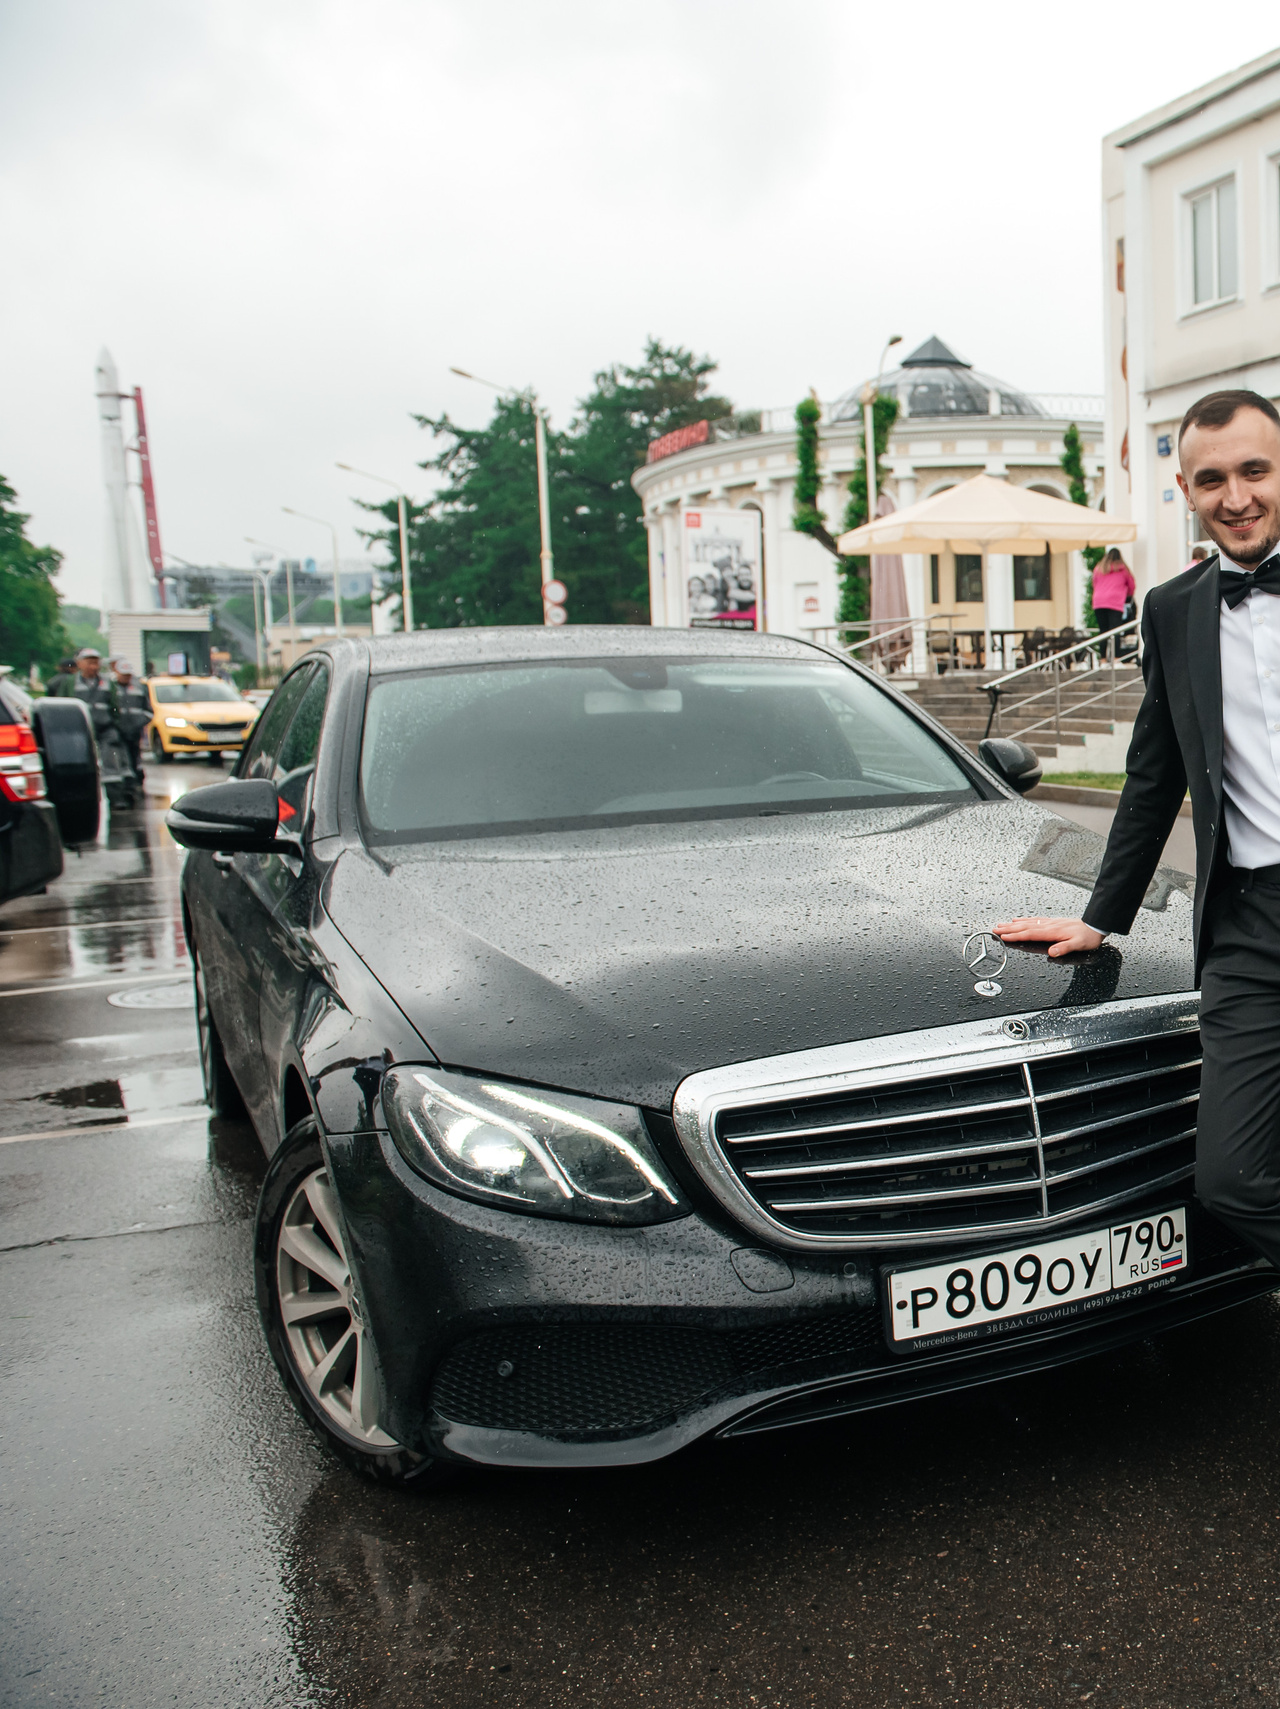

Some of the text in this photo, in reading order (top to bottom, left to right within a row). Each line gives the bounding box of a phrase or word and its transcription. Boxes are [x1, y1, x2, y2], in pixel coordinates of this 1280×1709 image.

[1113, 1215, 1175, 1266] 790
[1129, 1257, 1161, 1279] RUS
[912, 1275, 1177, 1350] Mercedes-Benz ЗВЕЗДА СТОЛИЦЫ (495) 974-22-22 РОЛЬФ
